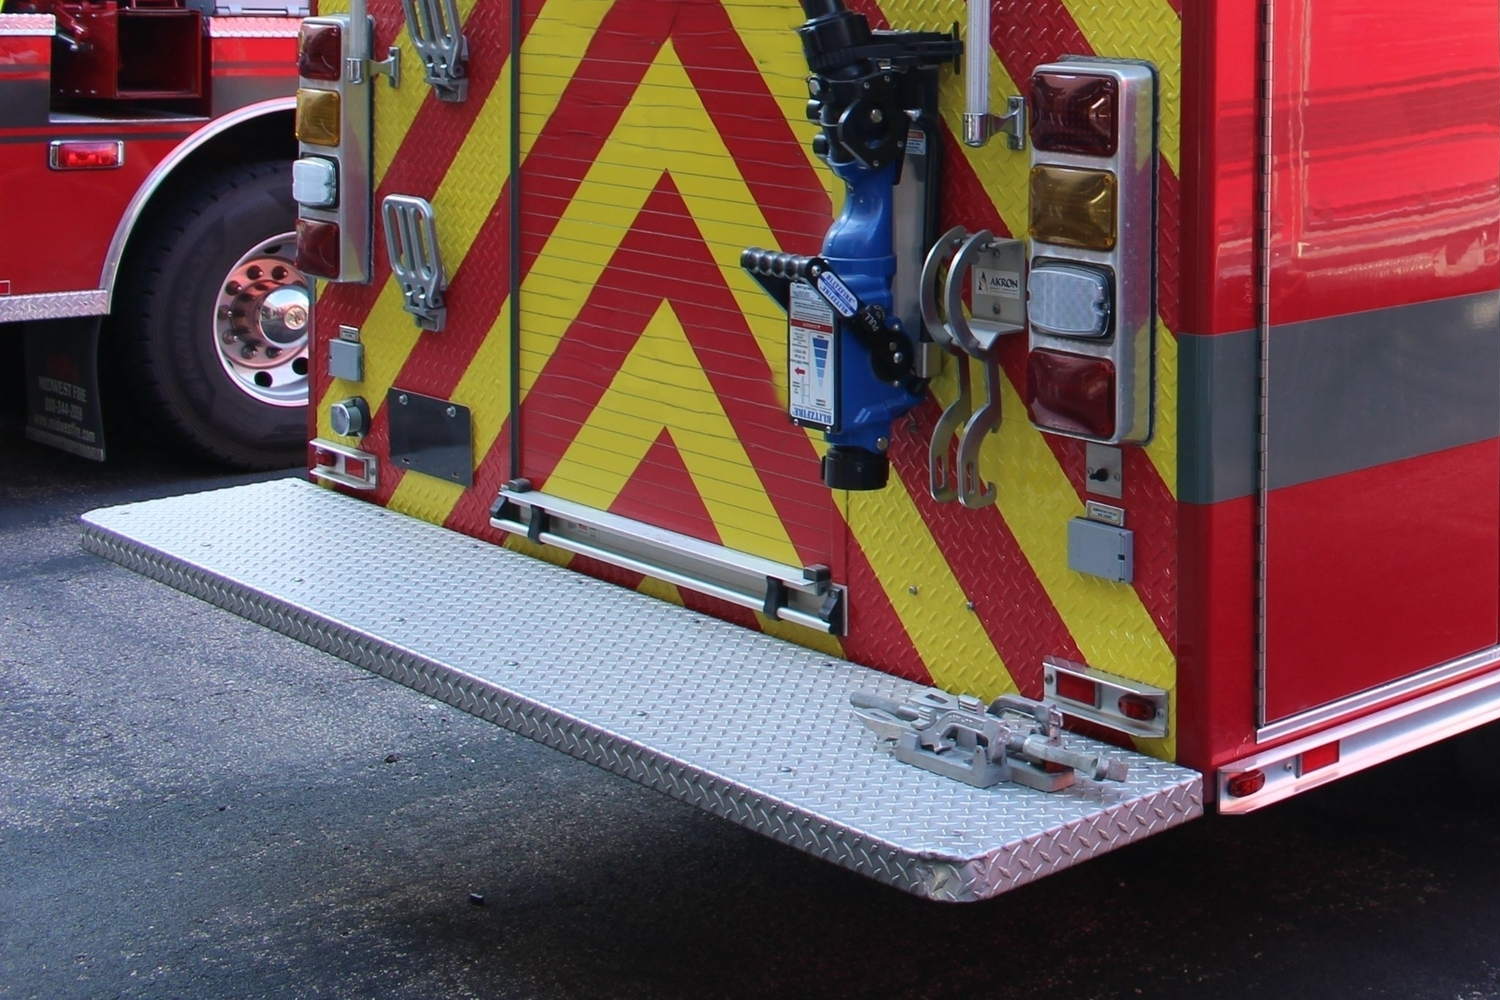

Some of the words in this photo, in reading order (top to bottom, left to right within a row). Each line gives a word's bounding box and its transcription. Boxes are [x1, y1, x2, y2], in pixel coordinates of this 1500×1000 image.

[826, 273, 853, 303] BLITZFIRE
[990, 277, 1018, 288] AKRON
[822, 286, 848, 315] BLITZFIRE
[865, 312, 879, 331] PULL
[38, 376, 71, 397] MIDWEST
[73, 385, 87, 403] FIRE
[794, 407, 832, 424] BLITZFIRE
